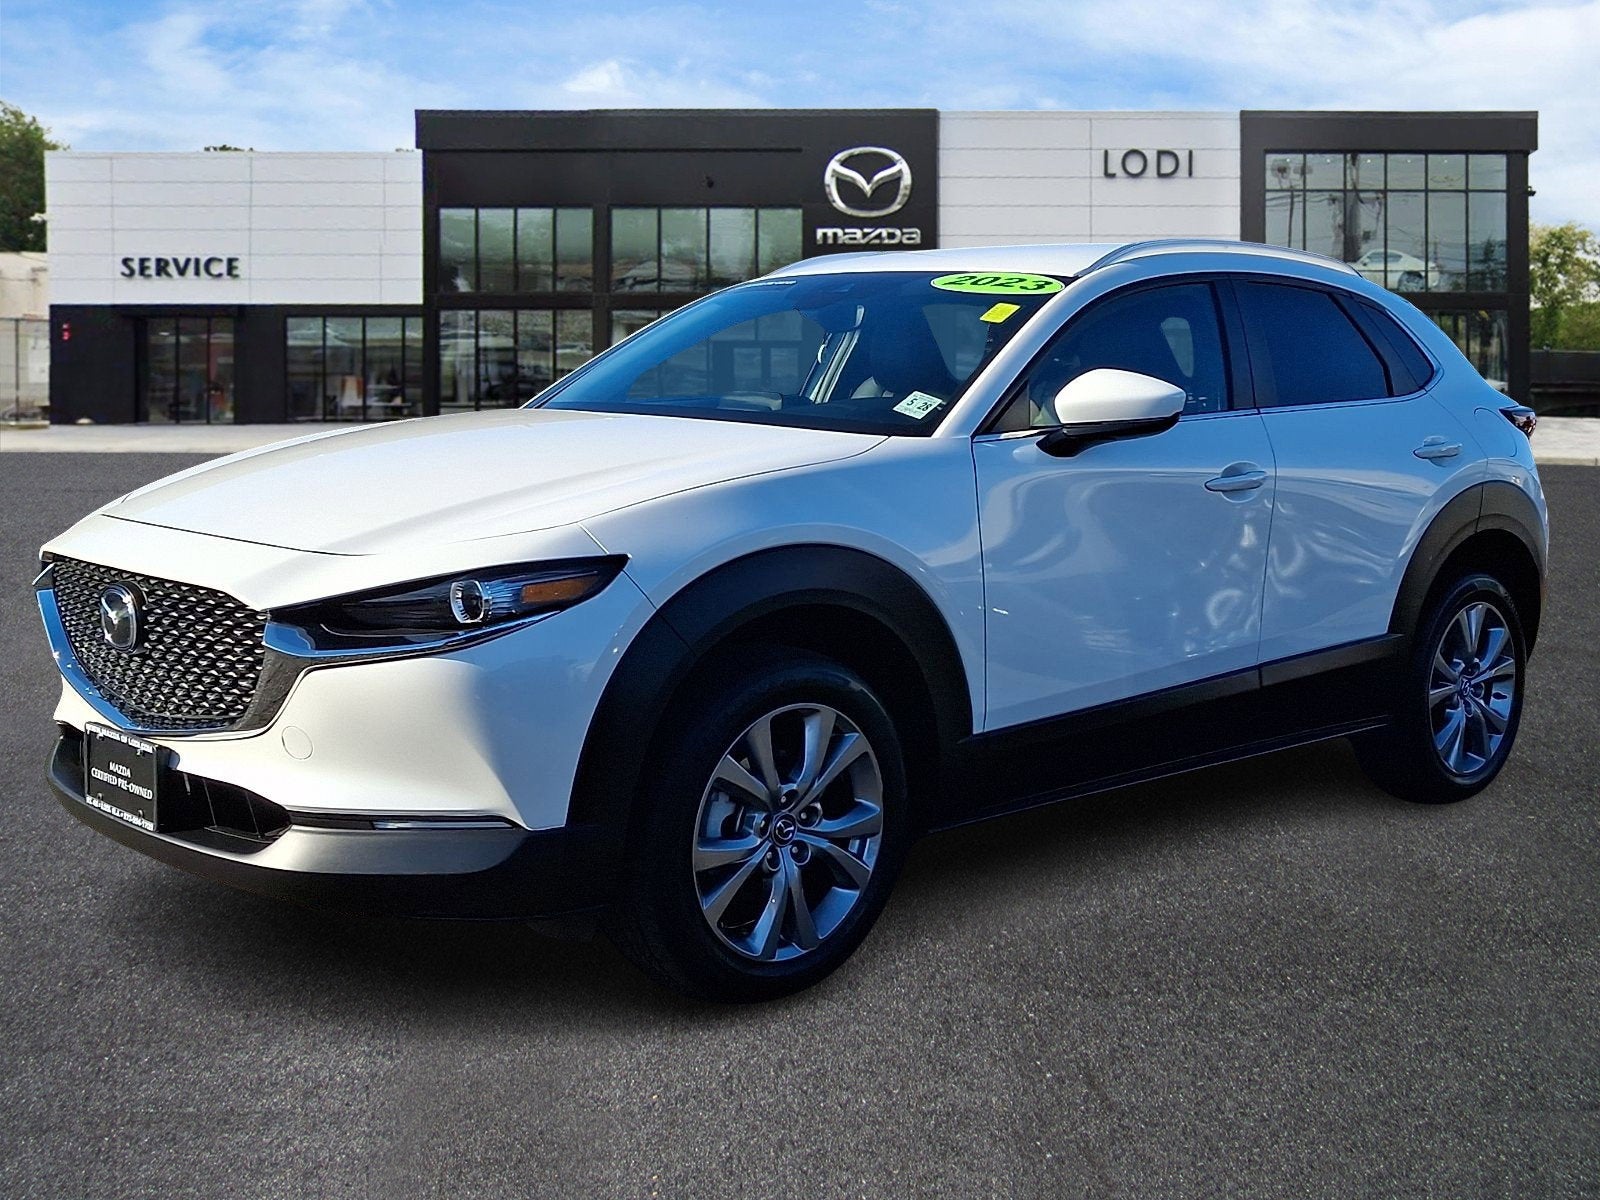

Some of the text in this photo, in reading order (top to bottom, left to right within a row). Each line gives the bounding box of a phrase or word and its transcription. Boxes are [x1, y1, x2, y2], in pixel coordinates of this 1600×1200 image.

[1104, 149, 1193, 178] LODI
[120, 256, 240, 278] SERVICE
[943, 275, 1053, 291] 2023
[906, 398, 919, 406] 5
[109, 761, 131, 777] MAZDA
[91, 767, 152, 799] CERTIFIED PRE-OWNED
